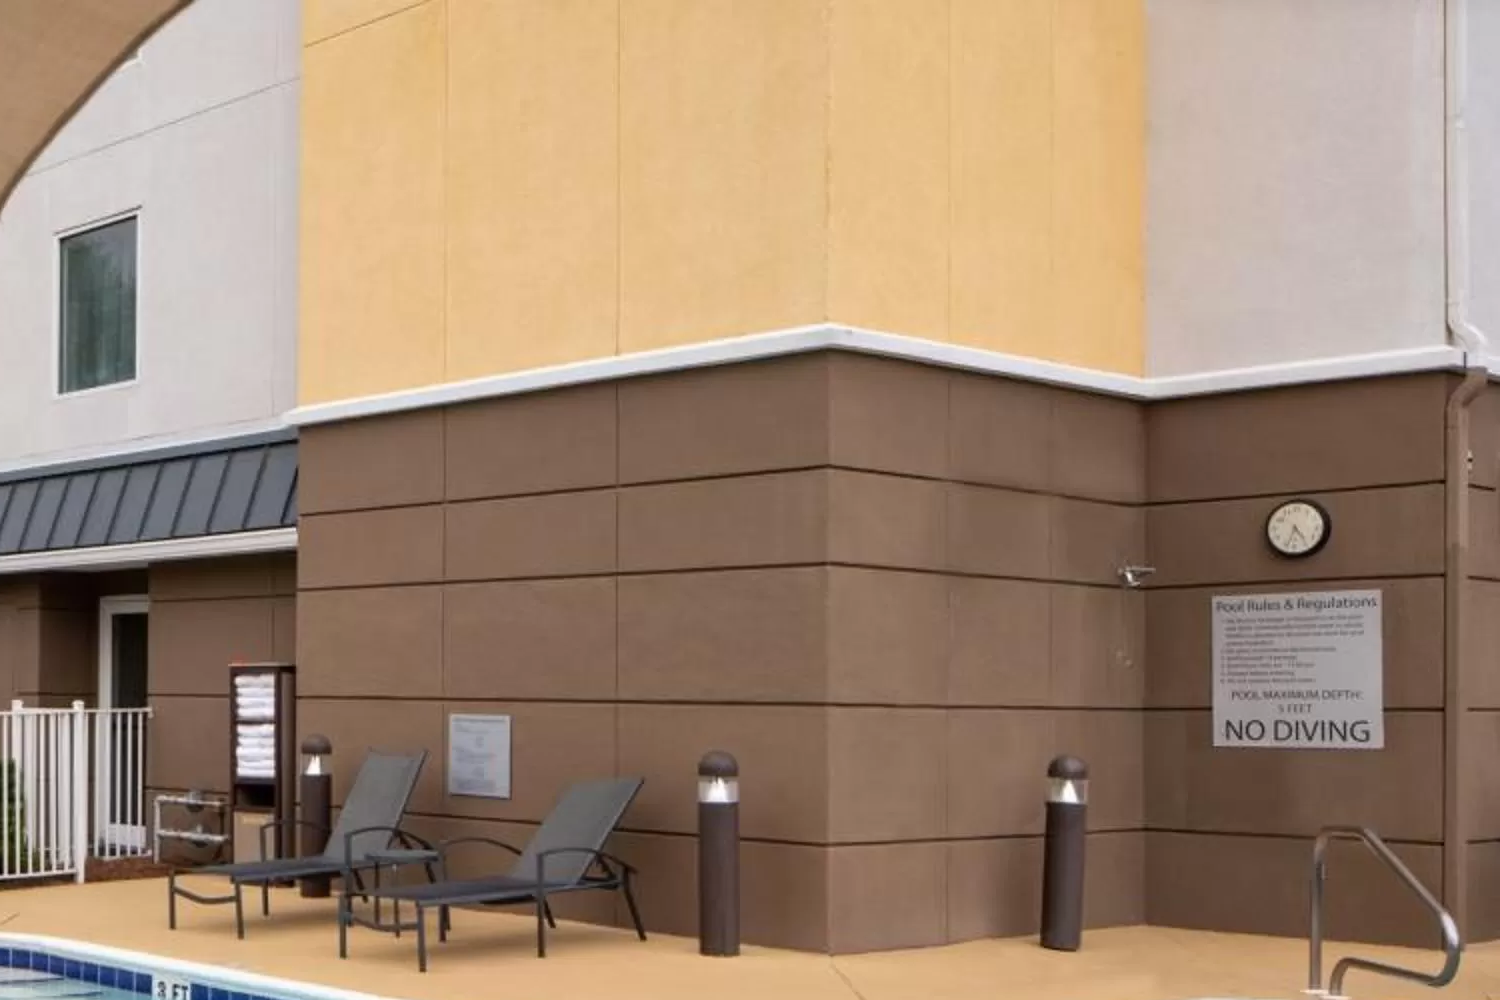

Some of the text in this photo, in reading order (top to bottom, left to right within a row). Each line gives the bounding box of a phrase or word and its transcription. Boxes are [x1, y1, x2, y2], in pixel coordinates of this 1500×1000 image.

[1216, 596, 1377, 613] Pool Rules & Regulations
[1231, 690, 1260, 701] POOL
[1263, 690, 1320, 701] MAXIMUM
[1287, 703, 1312, 713] FEET
[1225, 719, 1371, 743] NO DIVING
[173, 983, 189, 1000] FT
